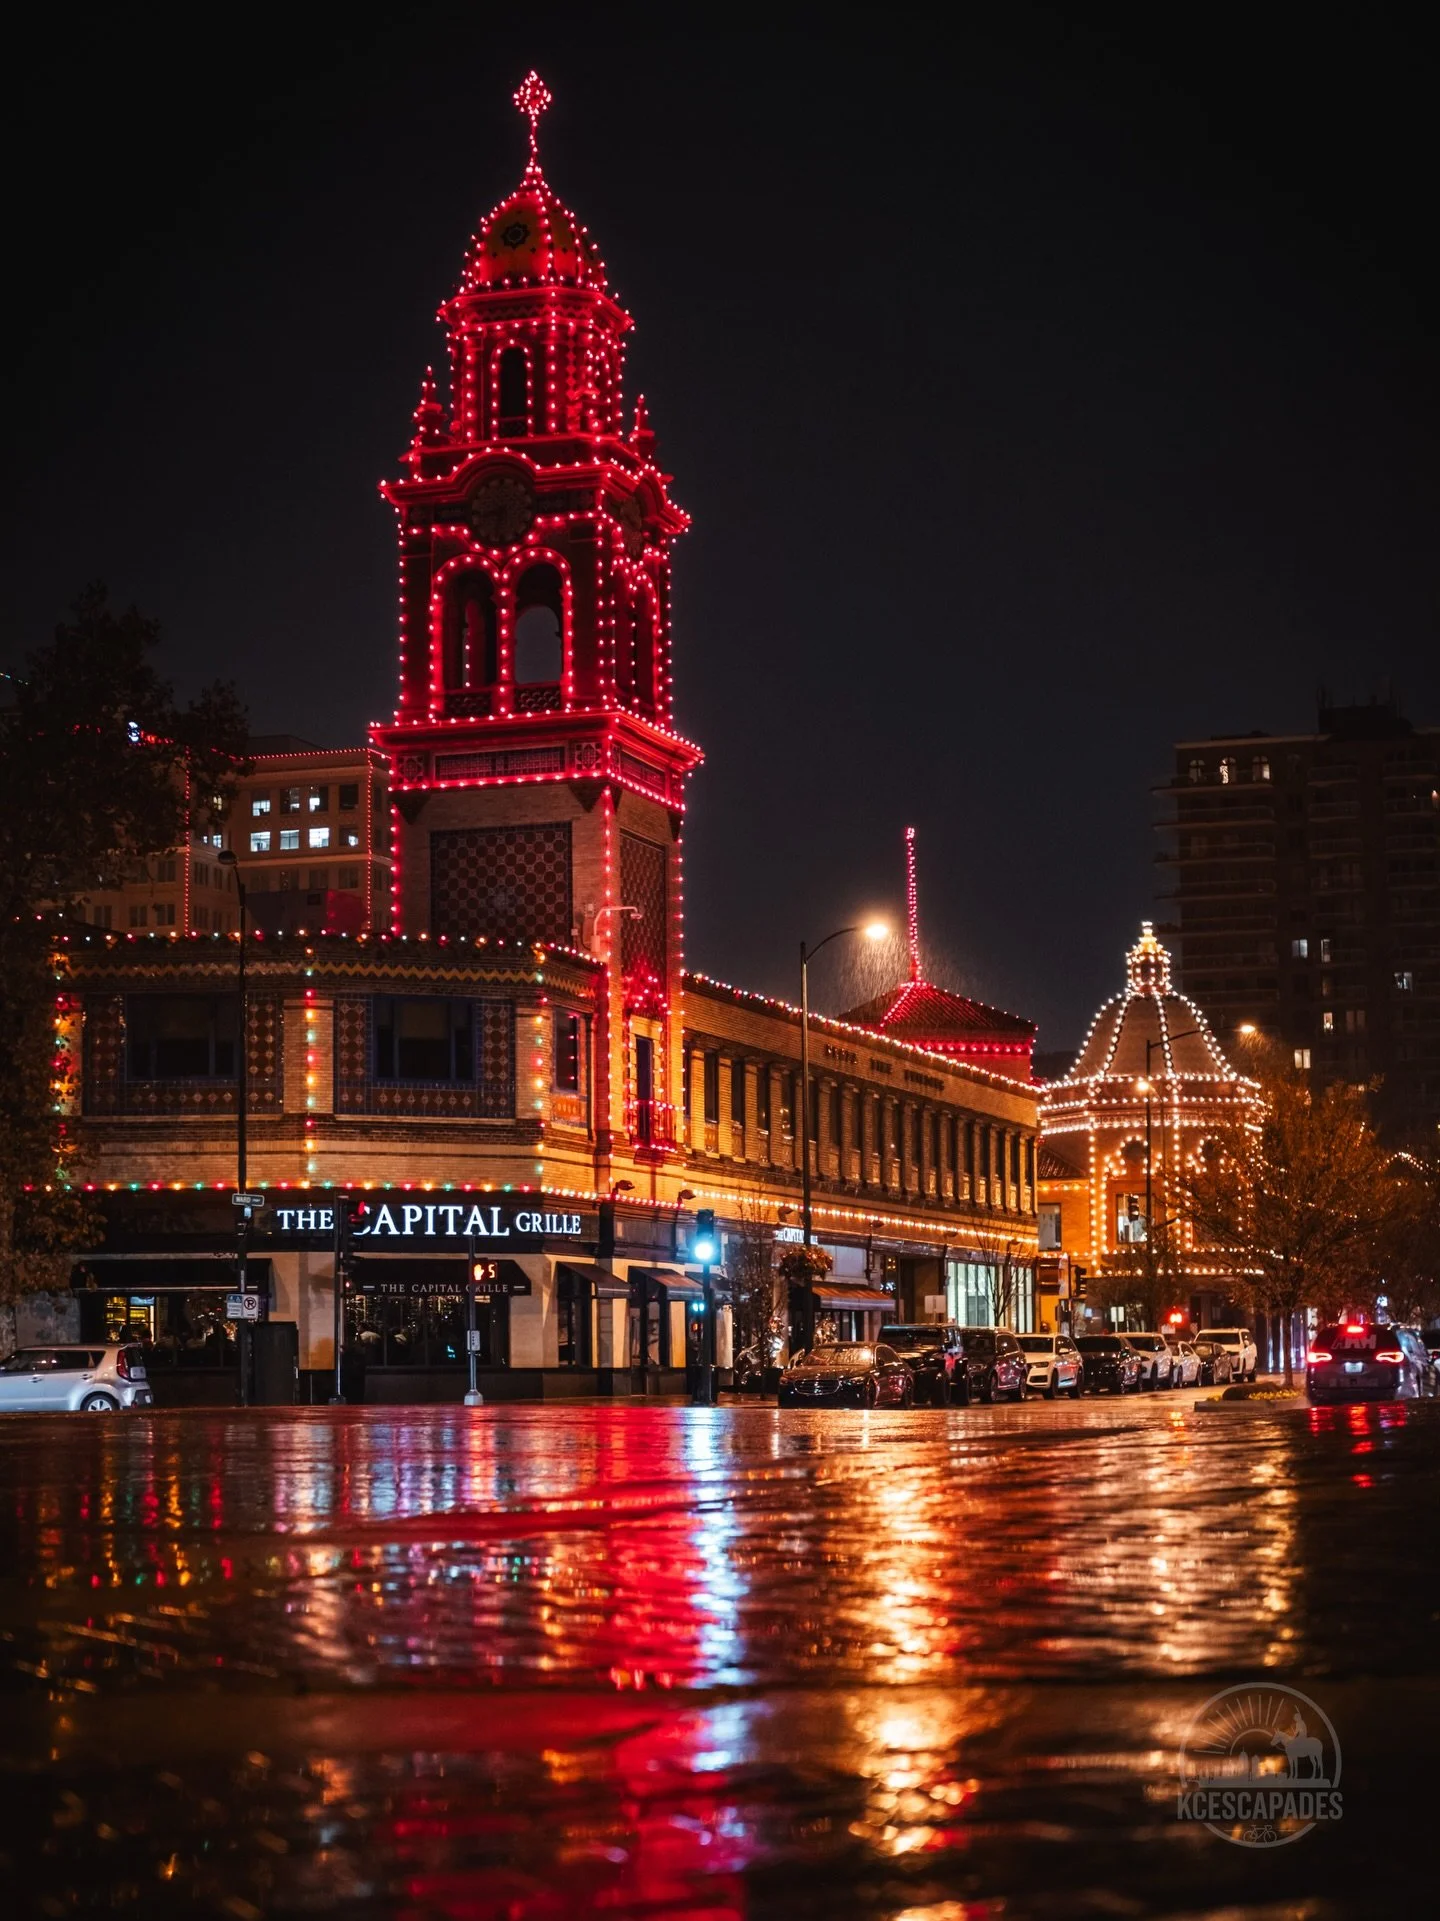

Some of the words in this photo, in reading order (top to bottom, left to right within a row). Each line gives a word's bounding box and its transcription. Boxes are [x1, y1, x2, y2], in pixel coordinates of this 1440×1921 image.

[276, 1209, 335, 1230] THE
[515, 1212, 582, 1235] GRILLE
[487, 1263, 496, 1279] 5
[380, 1283, 405, 1293] THE
[411, 1283, 461, 1293] CAPITAL
